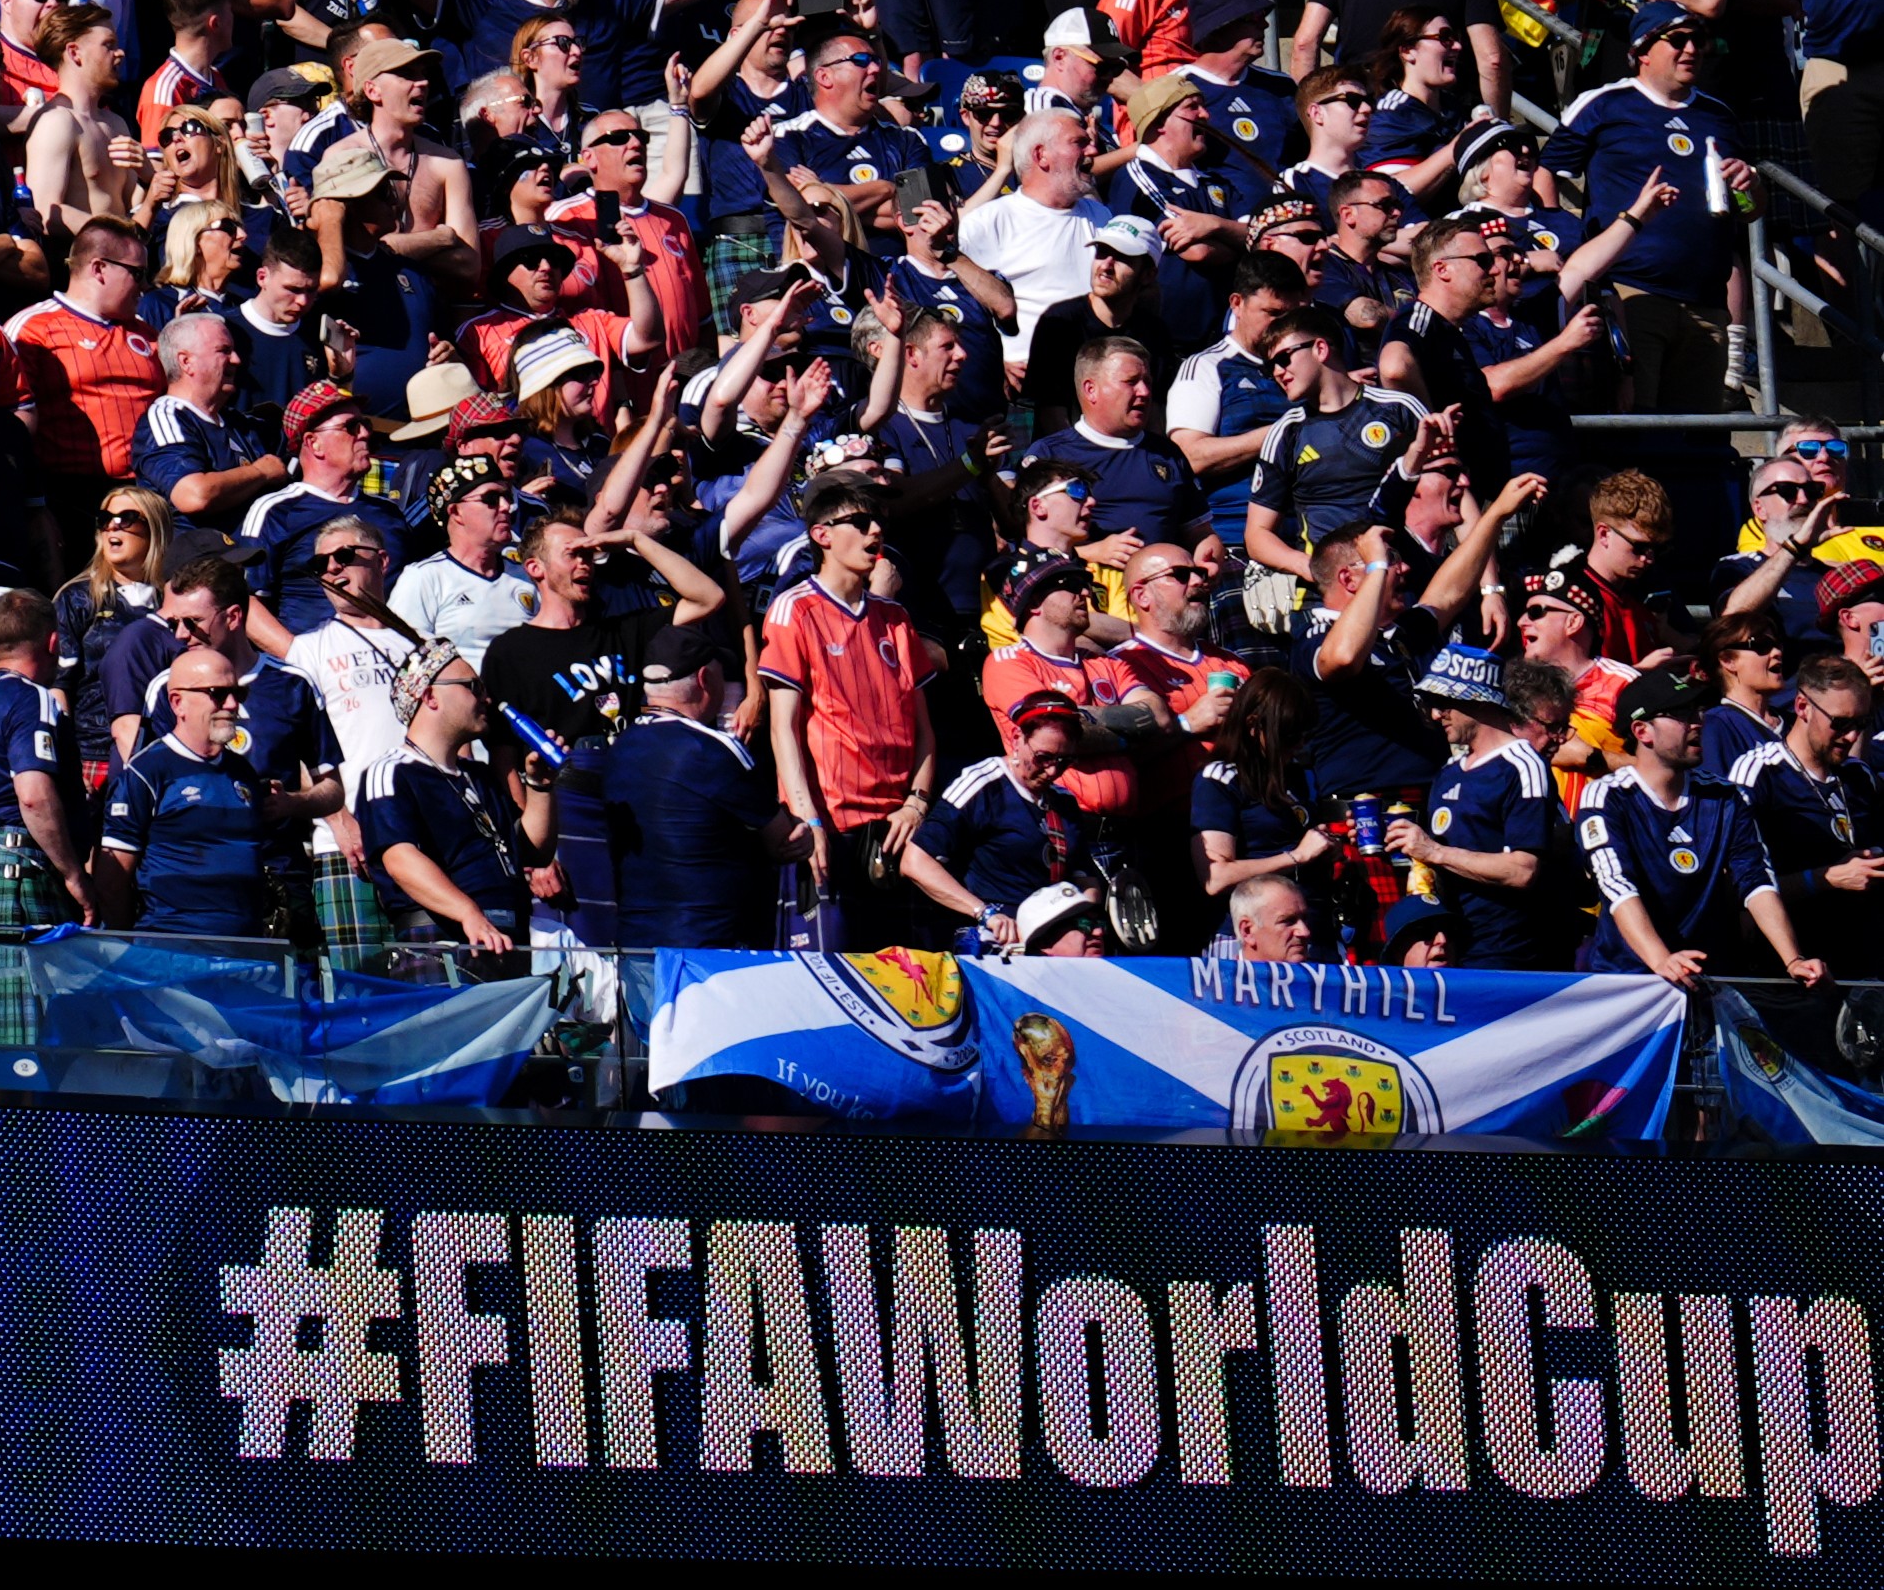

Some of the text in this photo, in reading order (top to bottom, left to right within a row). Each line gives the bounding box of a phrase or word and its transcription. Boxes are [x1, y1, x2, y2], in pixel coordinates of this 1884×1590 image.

[1554, 50, 1565, 71] 16
[839, 991, 872, 1019] EST
[1190, 958, 1456, 1023] MARYHILL
[1283, 1031, 1376, 1054] SCOTLAND
[777, 1058, 798, 1084] If
[802, 1069, 842, 1111] you
[217, 1206, 1882, 1556] #FIFAWorldCup
